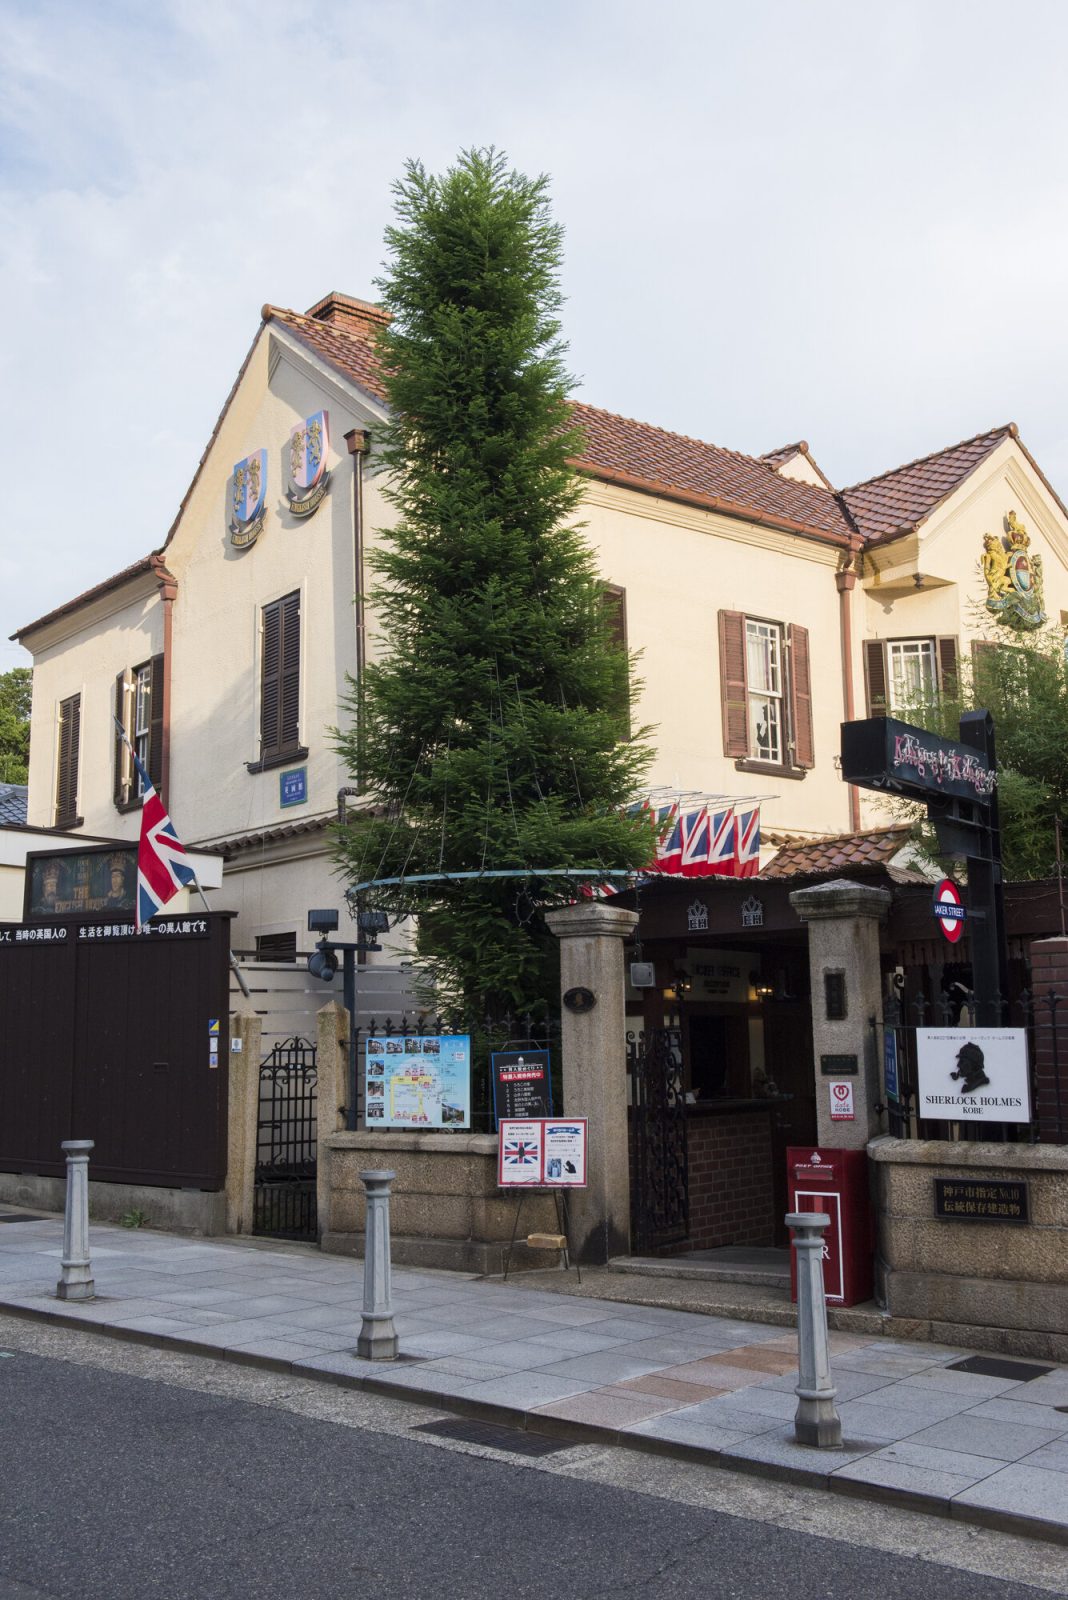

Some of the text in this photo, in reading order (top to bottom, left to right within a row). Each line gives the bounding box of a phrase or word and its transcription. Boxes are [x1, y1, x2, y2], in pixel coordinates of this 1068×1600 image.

[925, 1095, 1022, 1107] SHERLOCK HOLMES
[962, 1106, 984, 1115] KOBE
